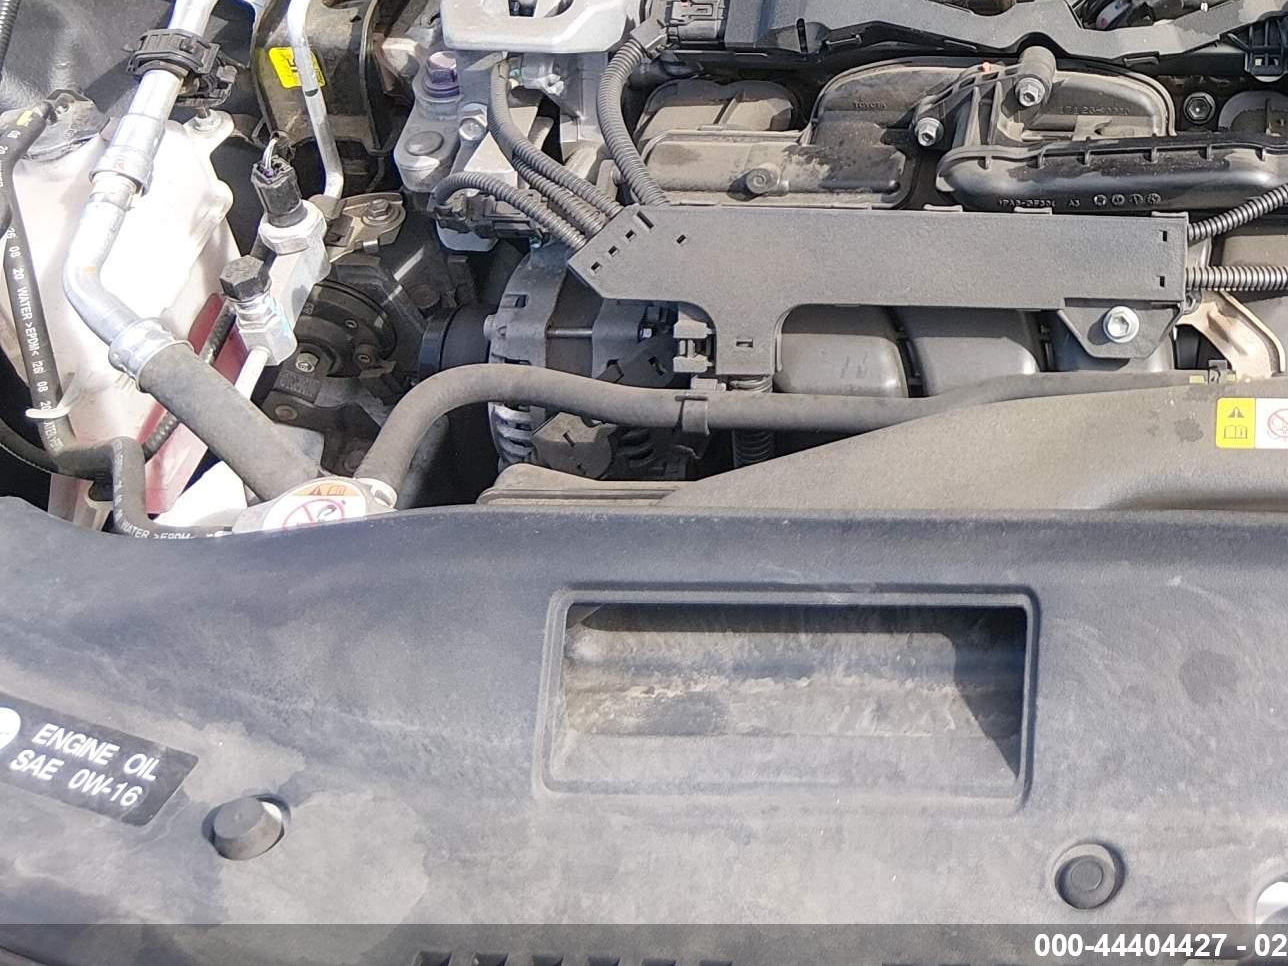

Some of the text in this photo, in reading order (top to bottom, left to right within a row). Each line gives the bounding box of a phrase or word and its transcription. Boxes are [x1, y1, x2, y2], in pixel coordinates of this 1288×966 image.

[13, 266, 25, 281] 20
[17, 286, 33, 321] WATER
[37, 380, 49, 393] 08
[119, 520, 150, 539] WATER
[32, 723, 160, 782] ENGINE OIL
[9, 749, 143, 807] SAE 0W-16
